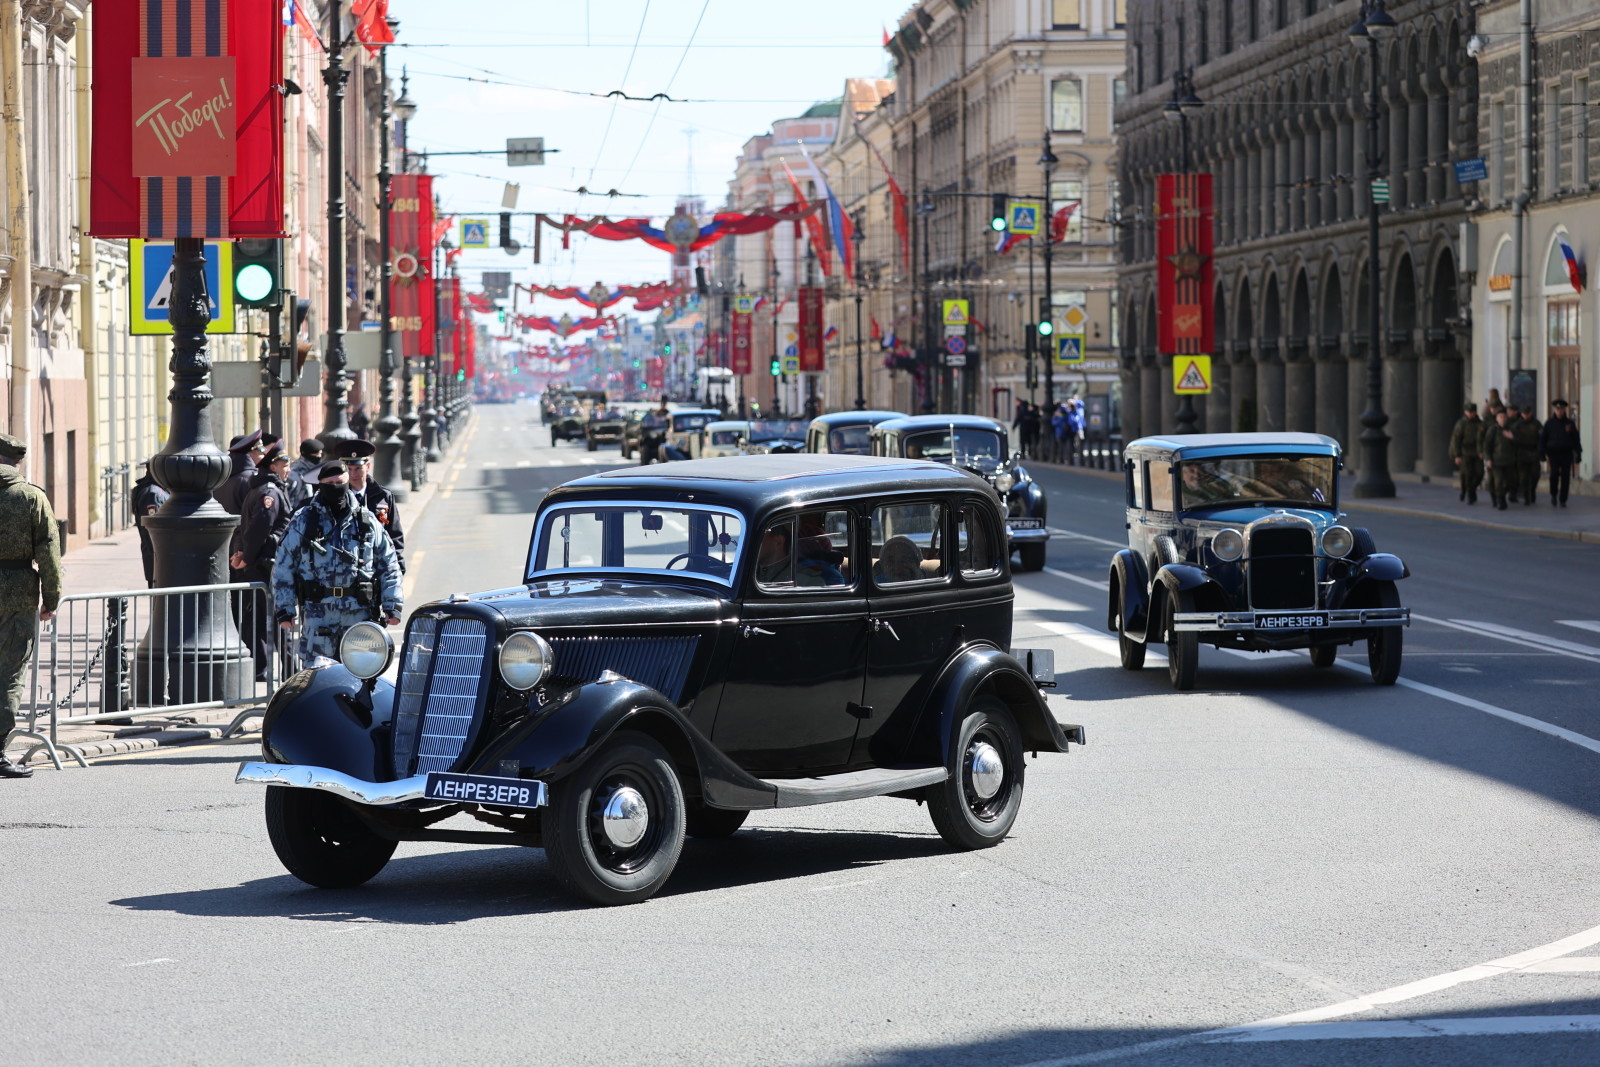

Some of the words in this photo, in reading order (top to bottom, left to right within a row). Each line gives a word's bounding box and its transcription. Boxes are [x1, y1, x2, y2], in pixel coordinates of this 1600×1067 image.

[135, 77, 233, 156] Победа!
[391, 198, 420, 212] 1941
[389, 316, 422, 331] 1945
[1260, 616, 1323, 628] ЛЕНРЕЗЕРВ
[433, 780, 530, 804] ЛЕНРЕЗЕРВ
